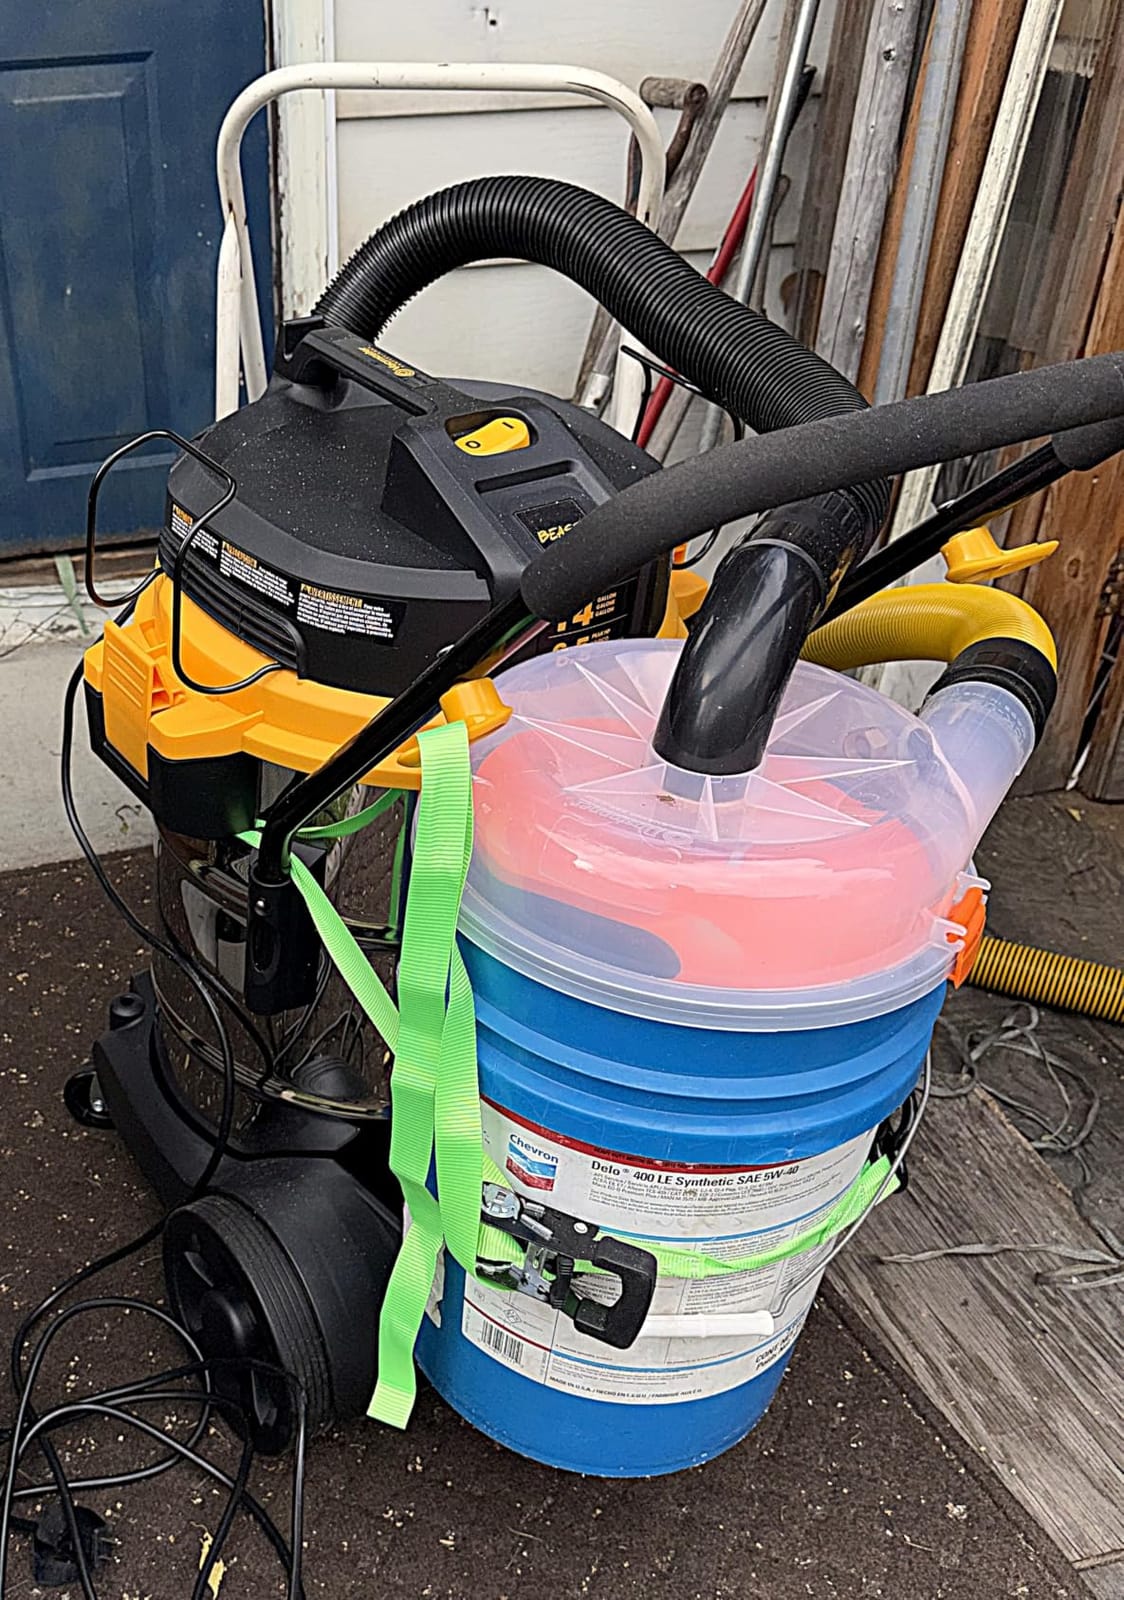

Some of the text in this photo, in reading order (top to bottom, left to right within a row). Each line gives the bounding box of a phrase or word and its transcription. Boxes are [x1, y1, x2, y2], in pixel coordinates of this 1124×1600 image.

[536, 521, 580, 544] BEAS
[510, 1134, 559, 1164] Chevron
[591, 1160, 621, 1177] Delo
[633, 1170, 655, 1184] 400
[657, 1173, 673, 1186] LE
[675, 1174, 734, 1188] Synthetic
[736, 1173, 761, 1186] SAE
[763, 1165, 800, 1182] 5W-40
